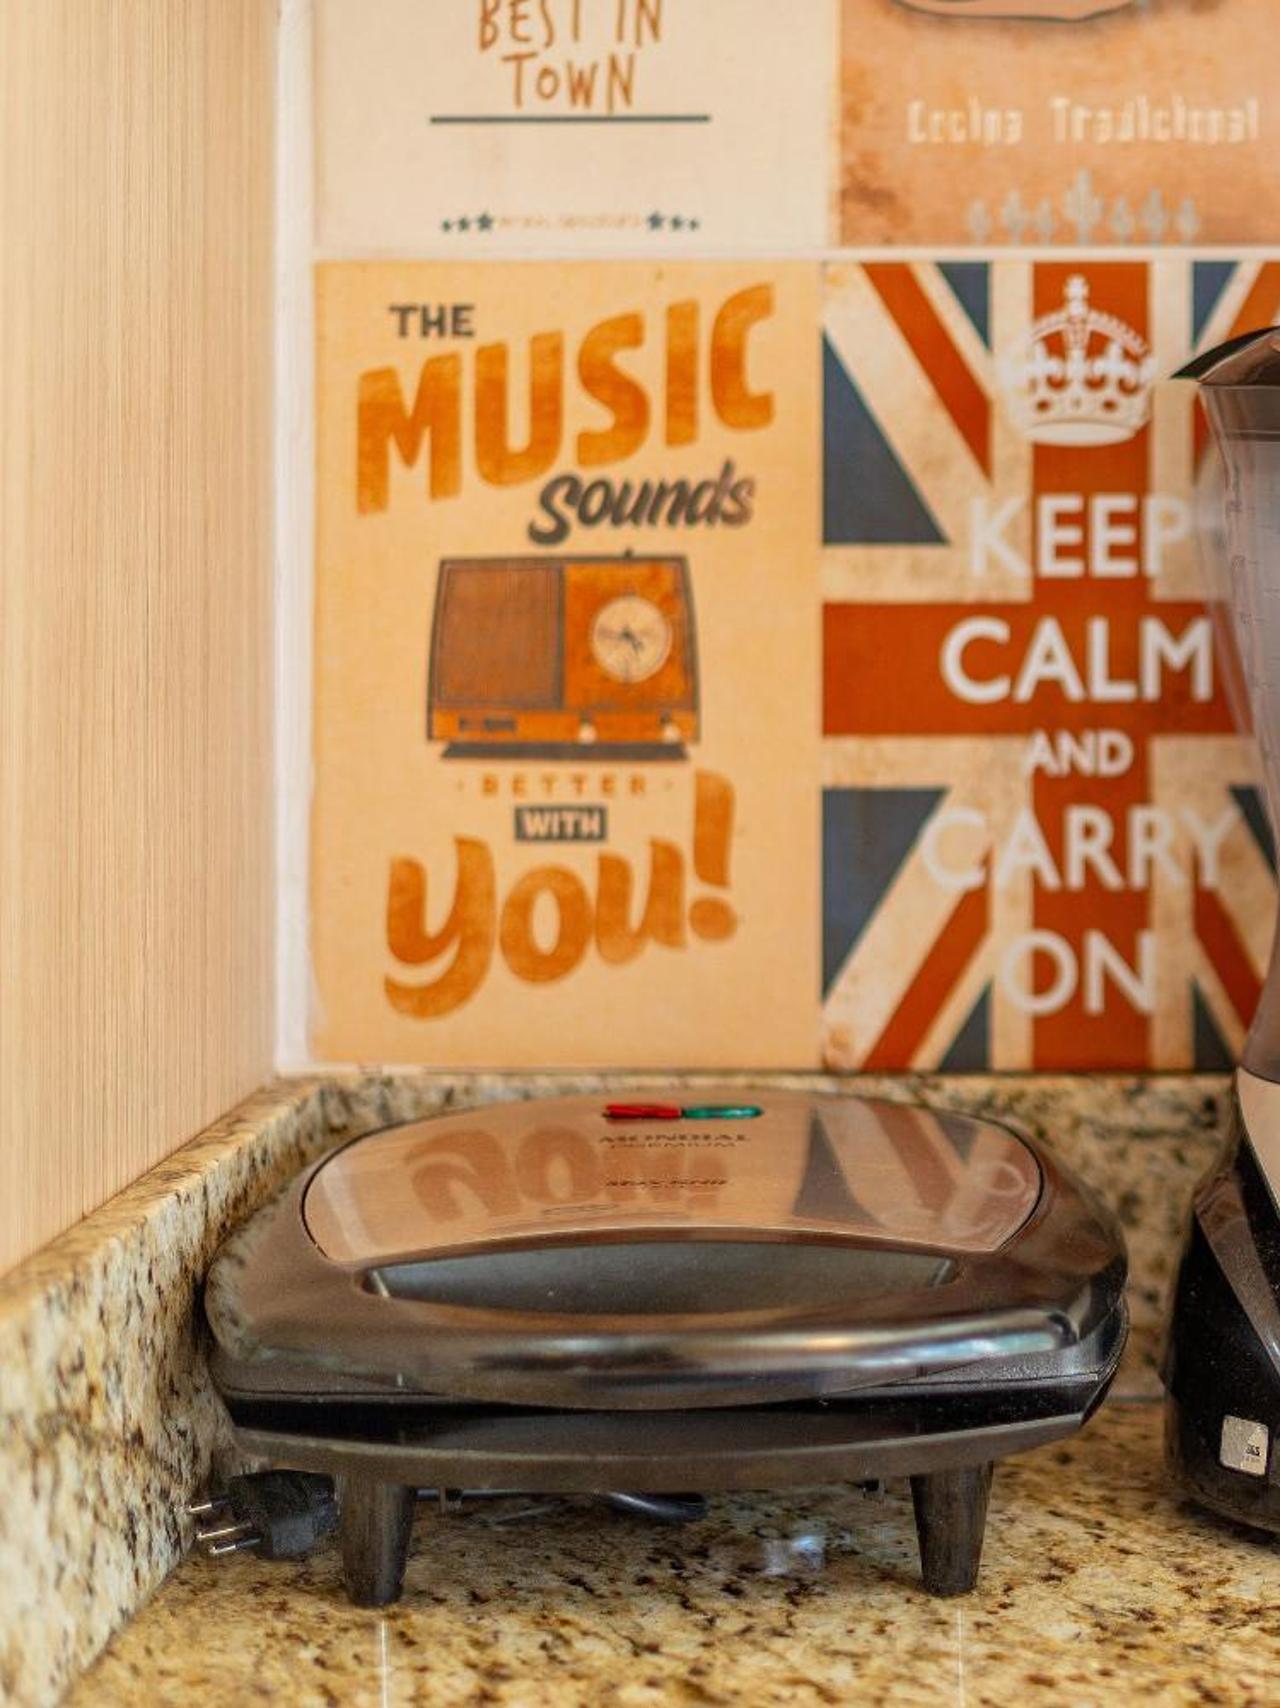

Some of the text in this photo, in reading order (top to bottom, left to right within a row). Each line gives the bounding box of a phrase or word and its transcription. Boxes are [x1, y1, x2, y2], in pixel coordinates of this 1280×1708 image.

[477, 0, 663, 51] BEST IN
[501, 51, 636, 116] TOWN
[388, 304, 477, 339] THE
[356, 283, 775, 517] MUSIC
[968, 494, 1192, 580] KEEP
[939, 616, 1213, 703] CALM
[482, 773, 646, 795] BETTER
[1023, 729, 1133, 776] AND
[522, 809, 602, 838] WITH
[920, 804, 1240, 891] CARRY
[383, 769, 738, 1022] you!
[1001, 927, 1158, 1016] ON
